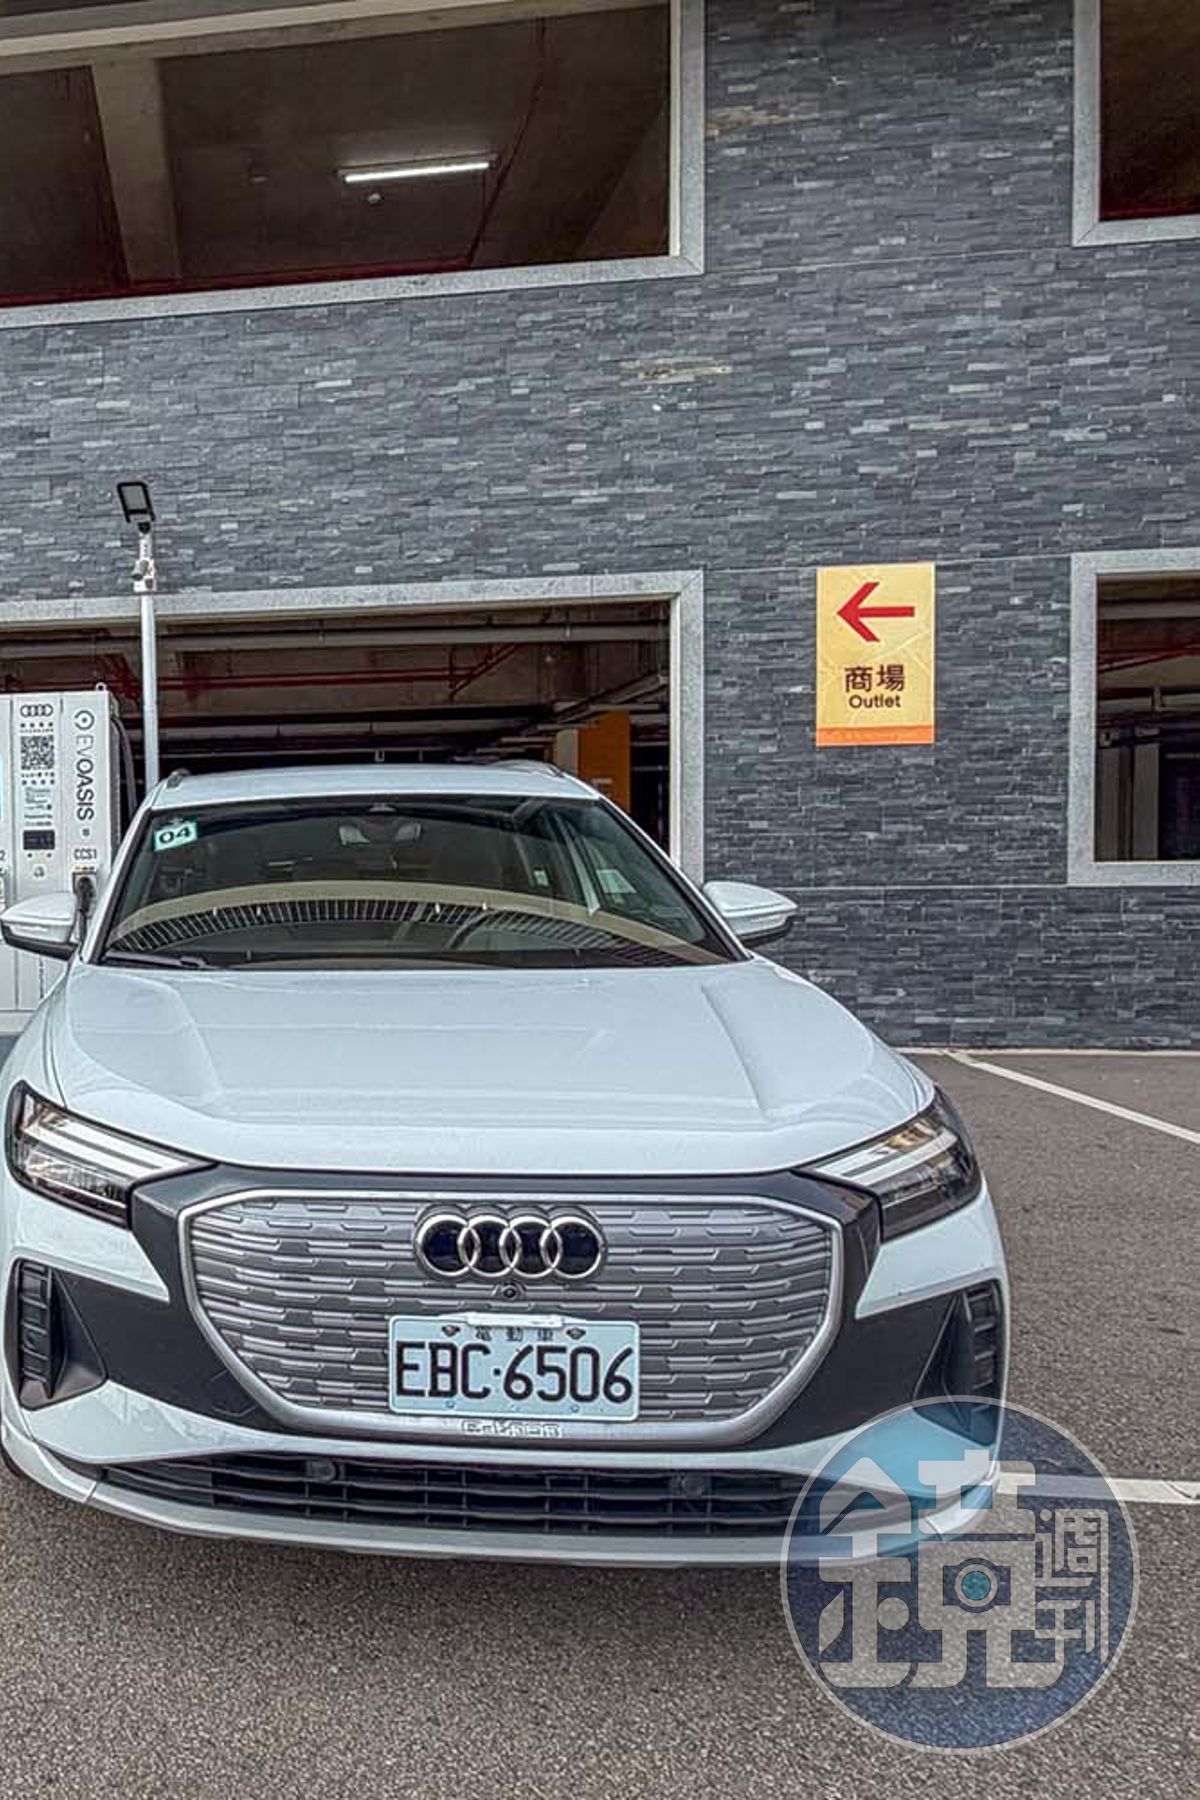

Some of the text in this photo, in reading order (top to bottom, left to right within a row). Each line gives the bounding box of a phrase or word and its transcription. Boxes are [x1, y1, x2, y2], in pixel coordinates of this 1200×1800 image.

[844, 664, 905, 692] 商場
[848, 695, 901, 709] Outlet
[75, 734, 95, 821] EVOASIS
[159, 826, 191, 844] 04
